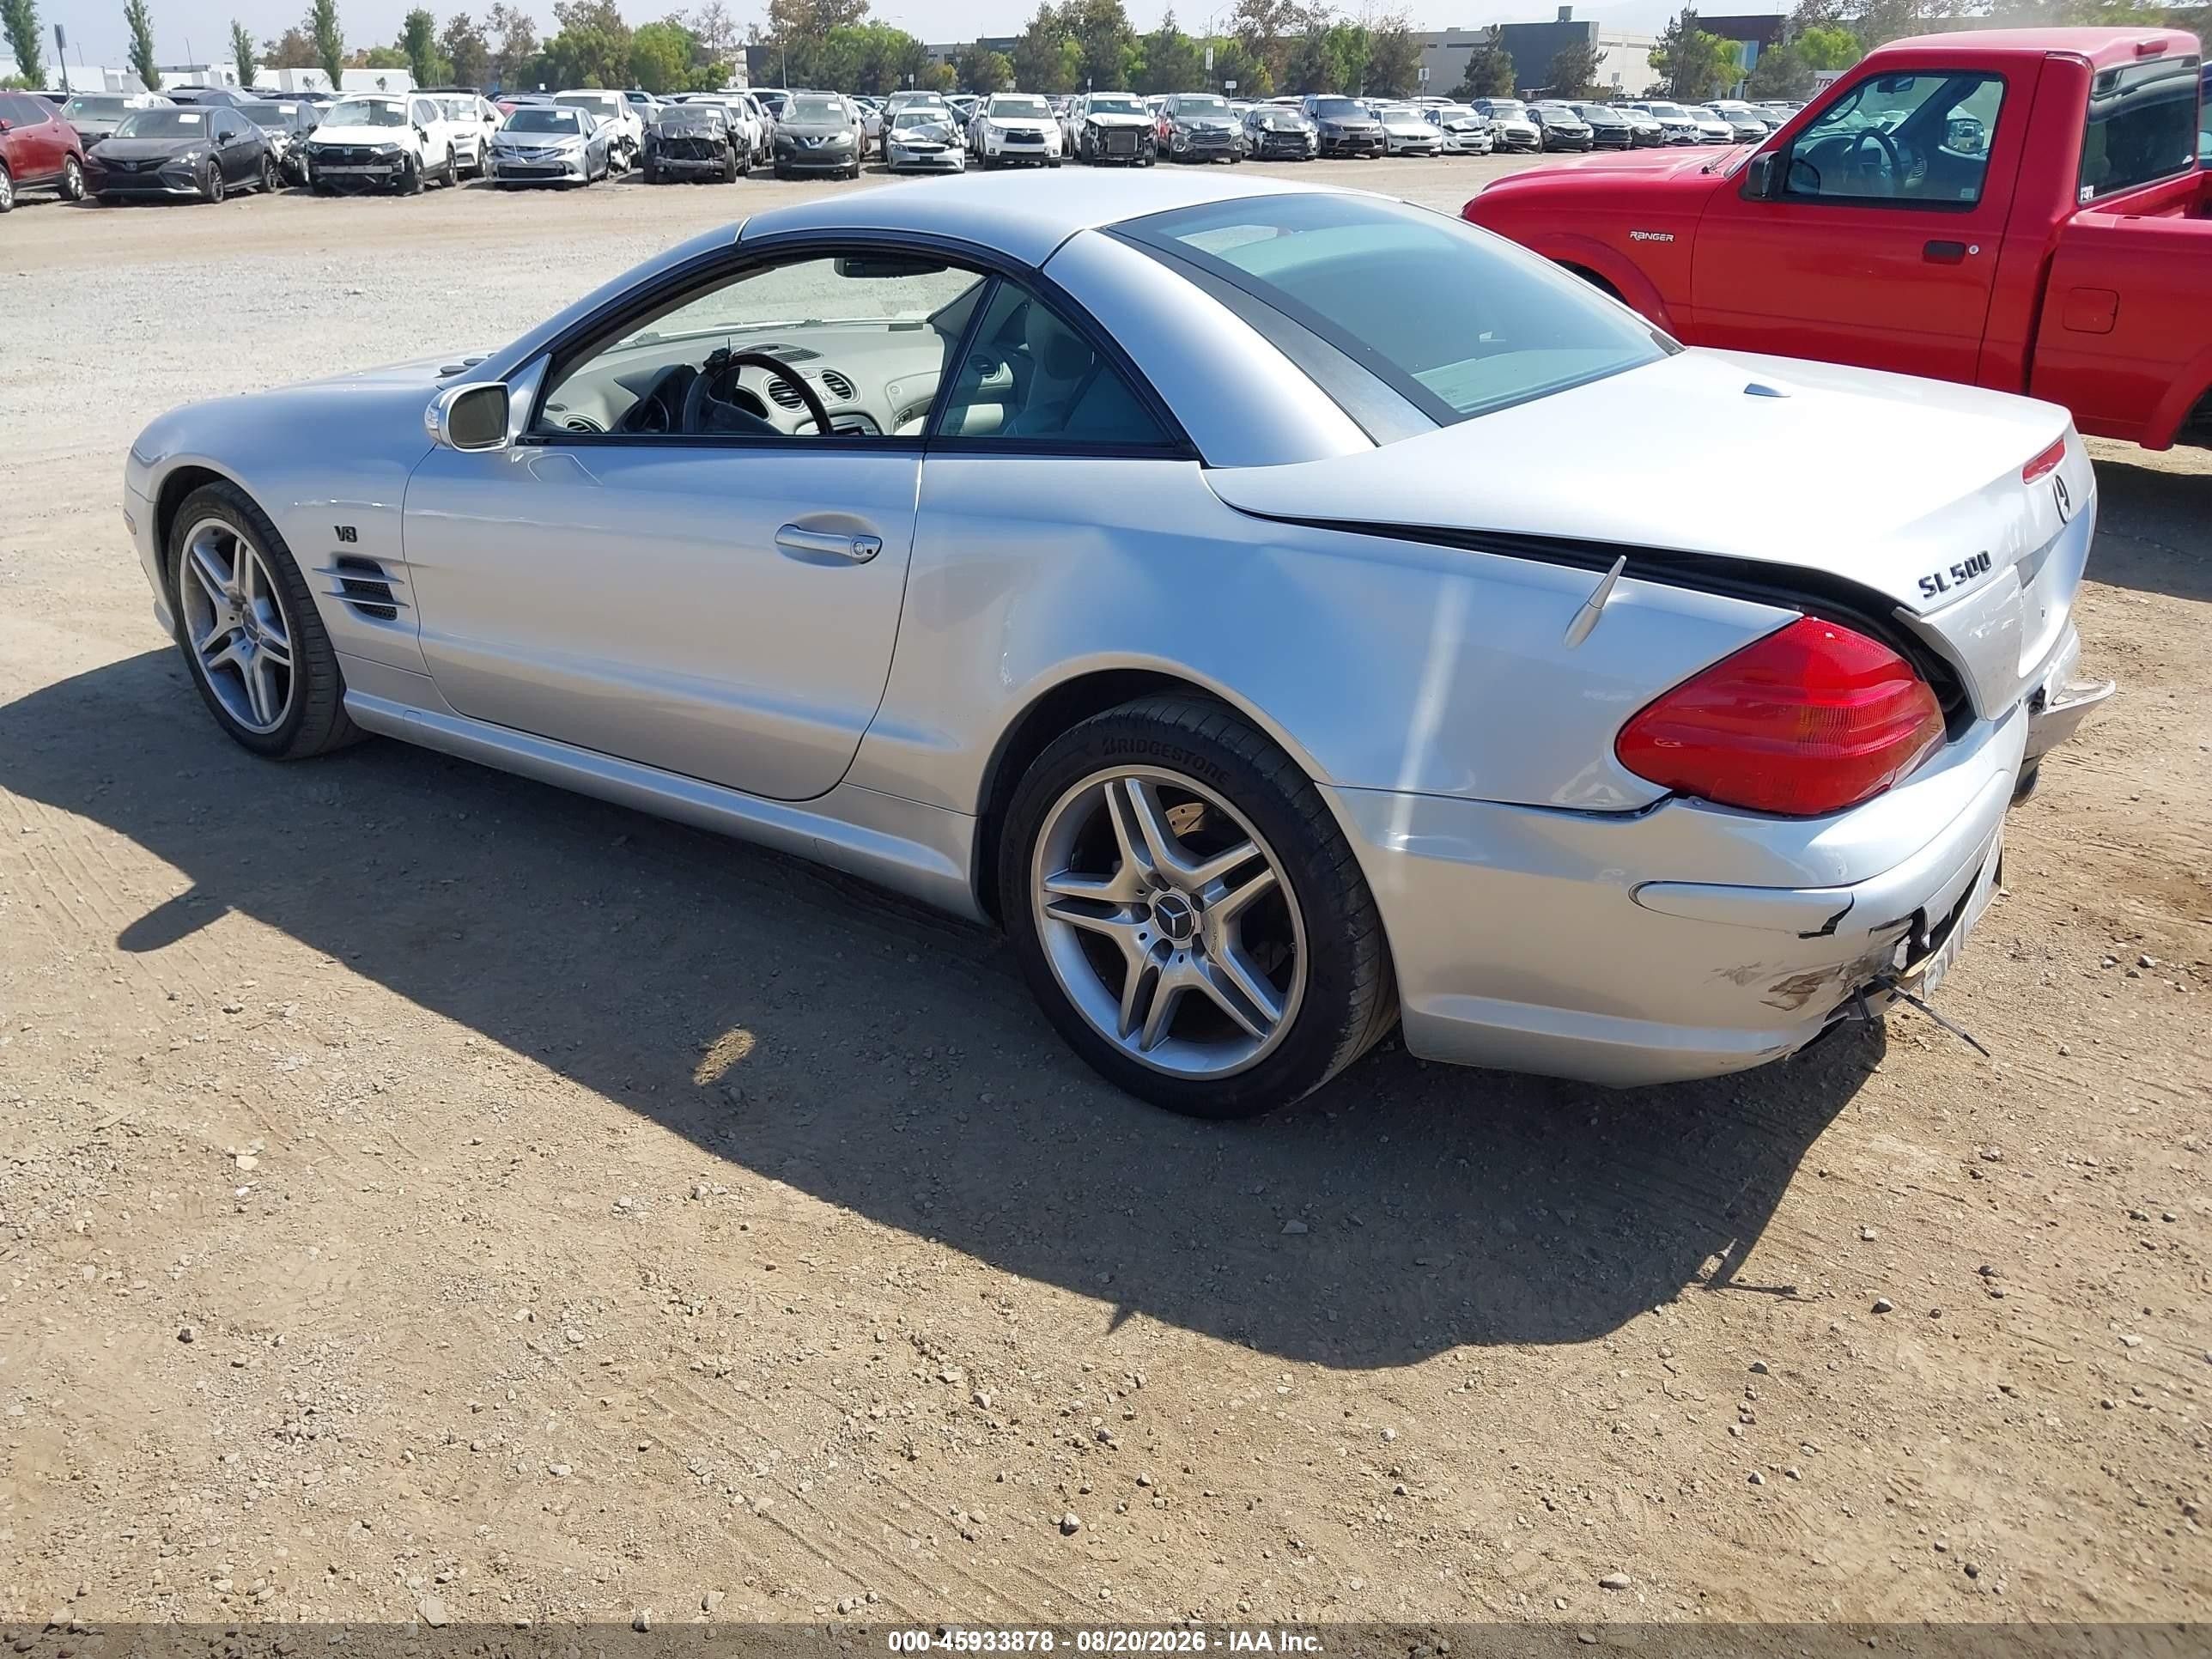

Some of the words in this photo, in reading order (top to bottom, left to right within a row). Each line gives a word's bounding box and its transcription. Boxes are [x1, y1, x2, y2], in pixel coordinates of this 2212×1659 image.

[1629, 230, 1674, 243] RANGER
[334, 526, 358, 544] V8
[1917, 571, 1952, 599] SL
[1948, 550, 1993, 586] 500
[1101, 734, 1232, 786] BRIDGESTONE
